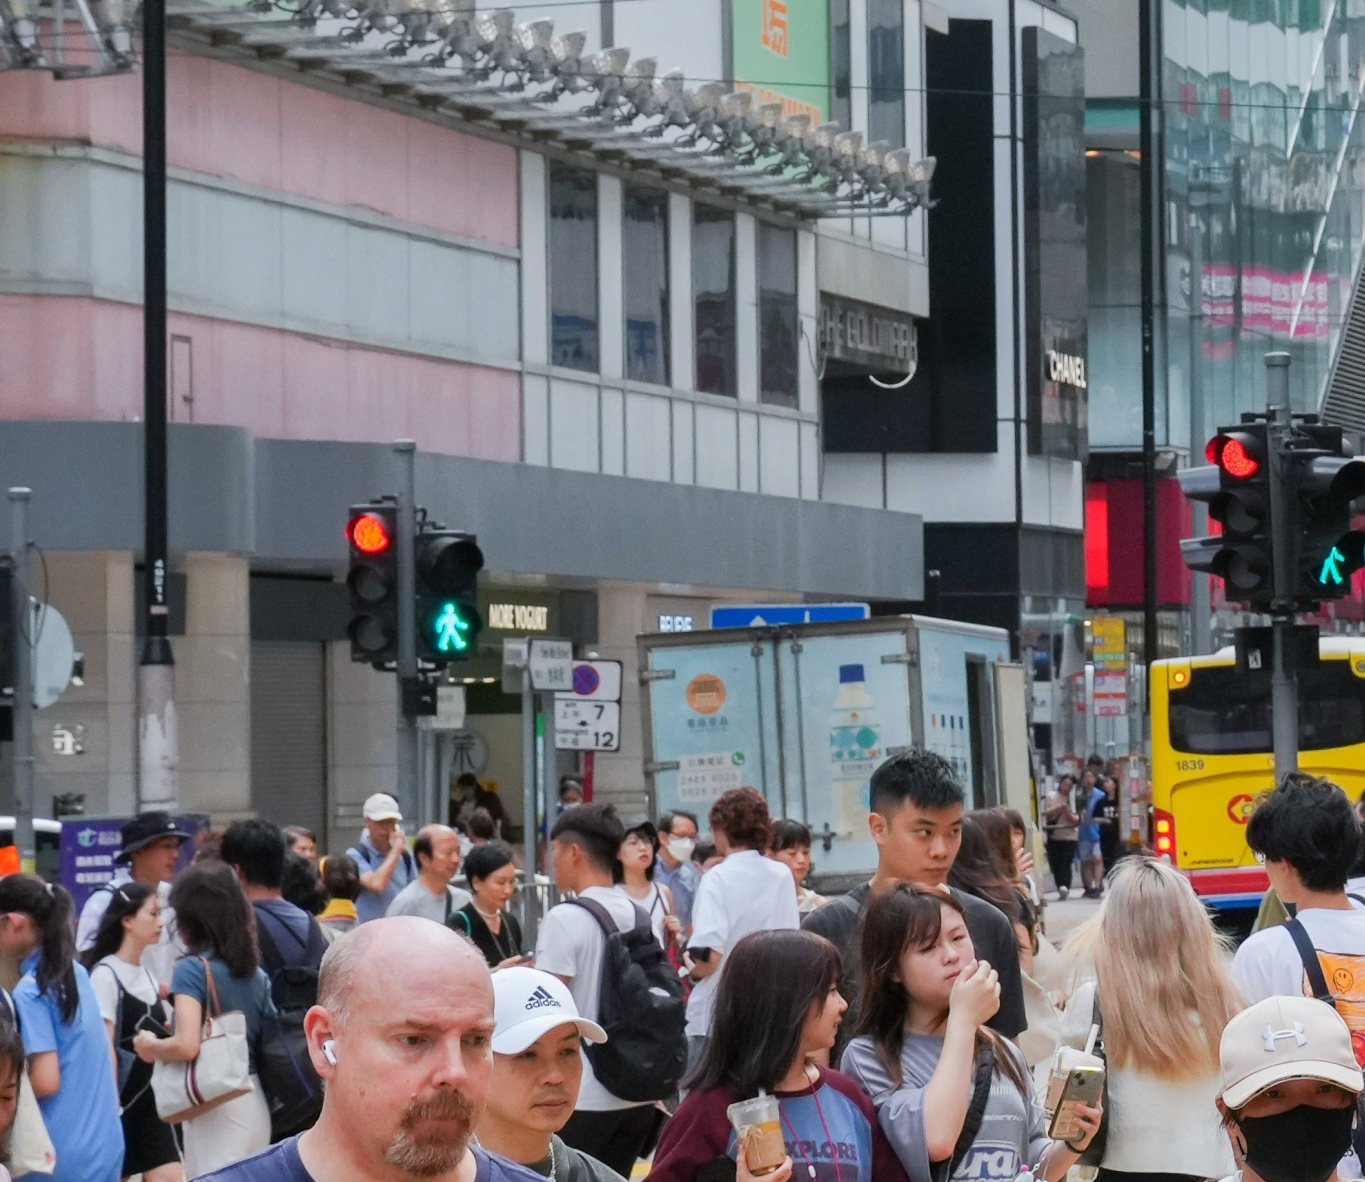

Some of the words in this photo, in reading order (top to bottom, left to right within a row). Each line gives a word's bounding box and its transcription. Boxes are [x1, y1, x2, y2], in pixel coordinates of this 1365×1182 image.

[1046, 350, 1087, 388] CHANEL
[489, 604, 514, 629] MORE
[515, 605, 548, 630] YOGURT
[593, 704, 605, 721] 7
[594, 732, 613, 748] 12
[525, 999, 562, 1010] adidas
